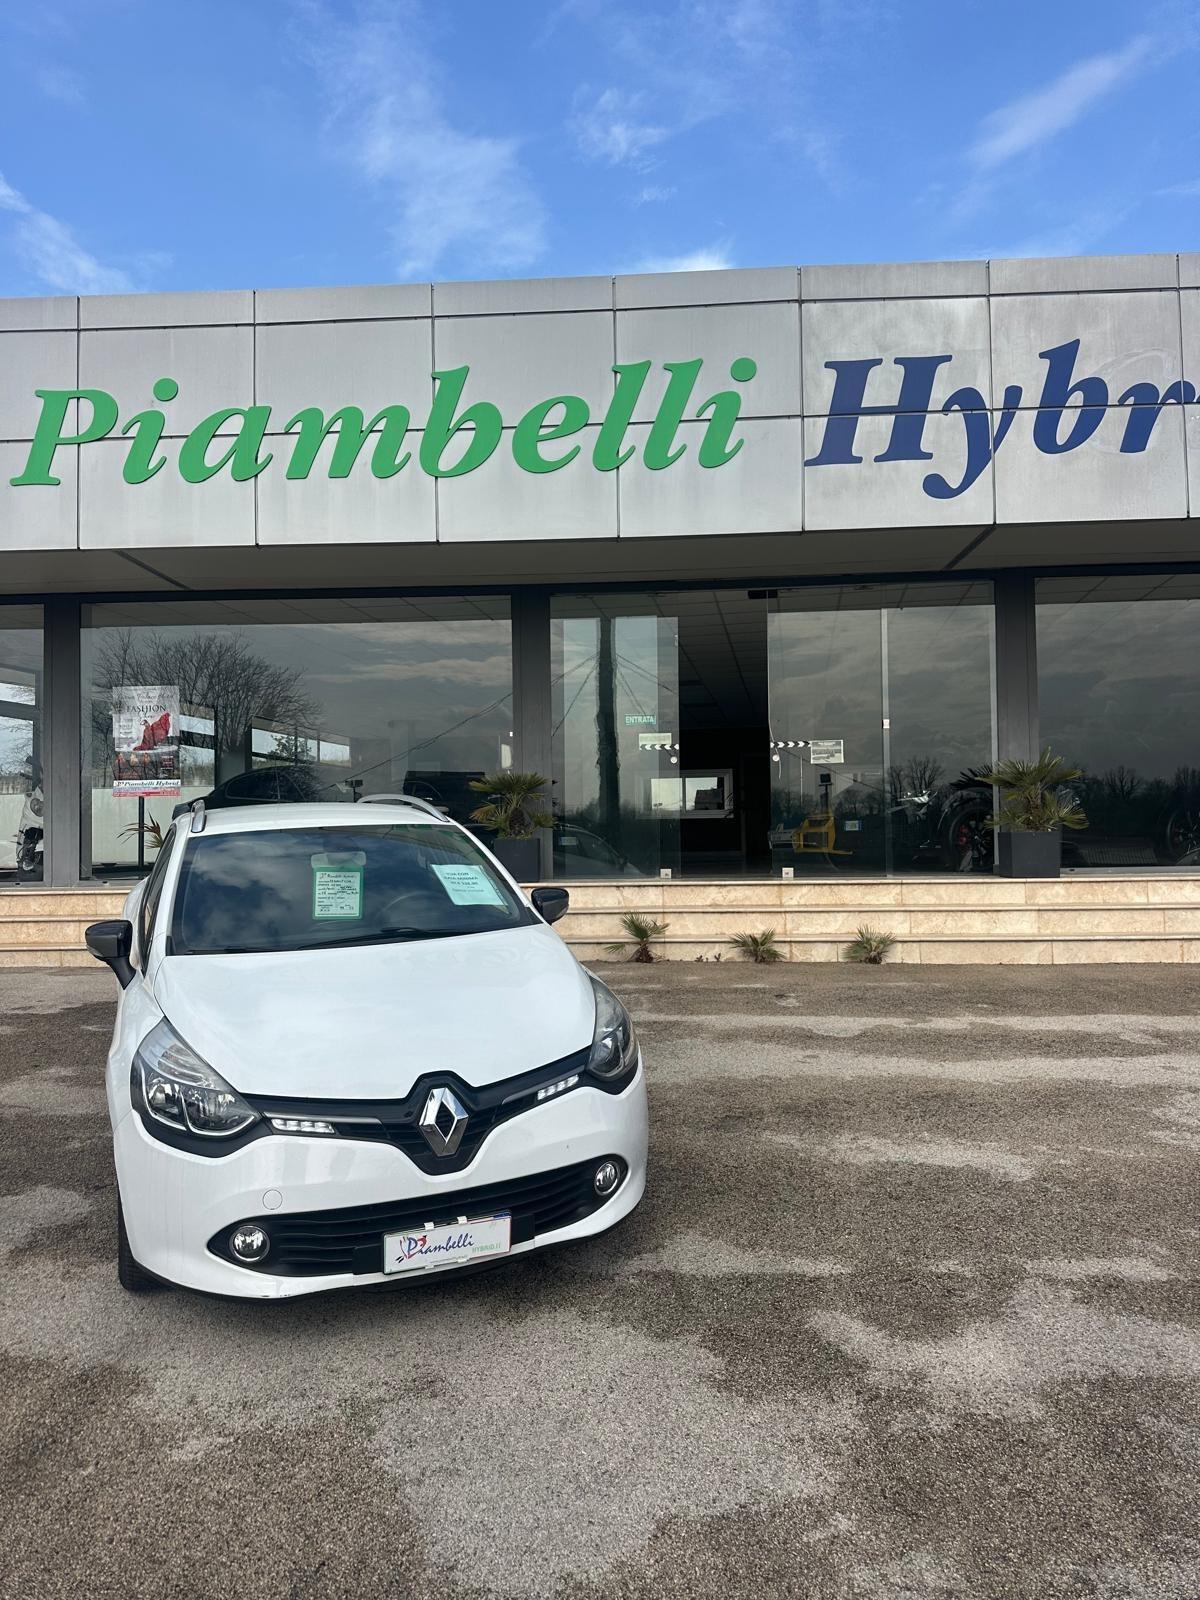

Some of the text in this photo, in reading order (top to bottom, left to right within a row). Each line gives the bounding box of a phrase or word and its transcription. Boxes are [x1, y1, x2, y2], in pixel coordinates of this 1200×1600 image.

[9, 338, 1200, 499] Piambelli Hybr
[126, 704, 166, 713] FASHION
[625, 715, 654, 723] ENTRATA
[124, 780, 154, 788] Piambelli
[406, 1232, 475, 1257] Piambelli
